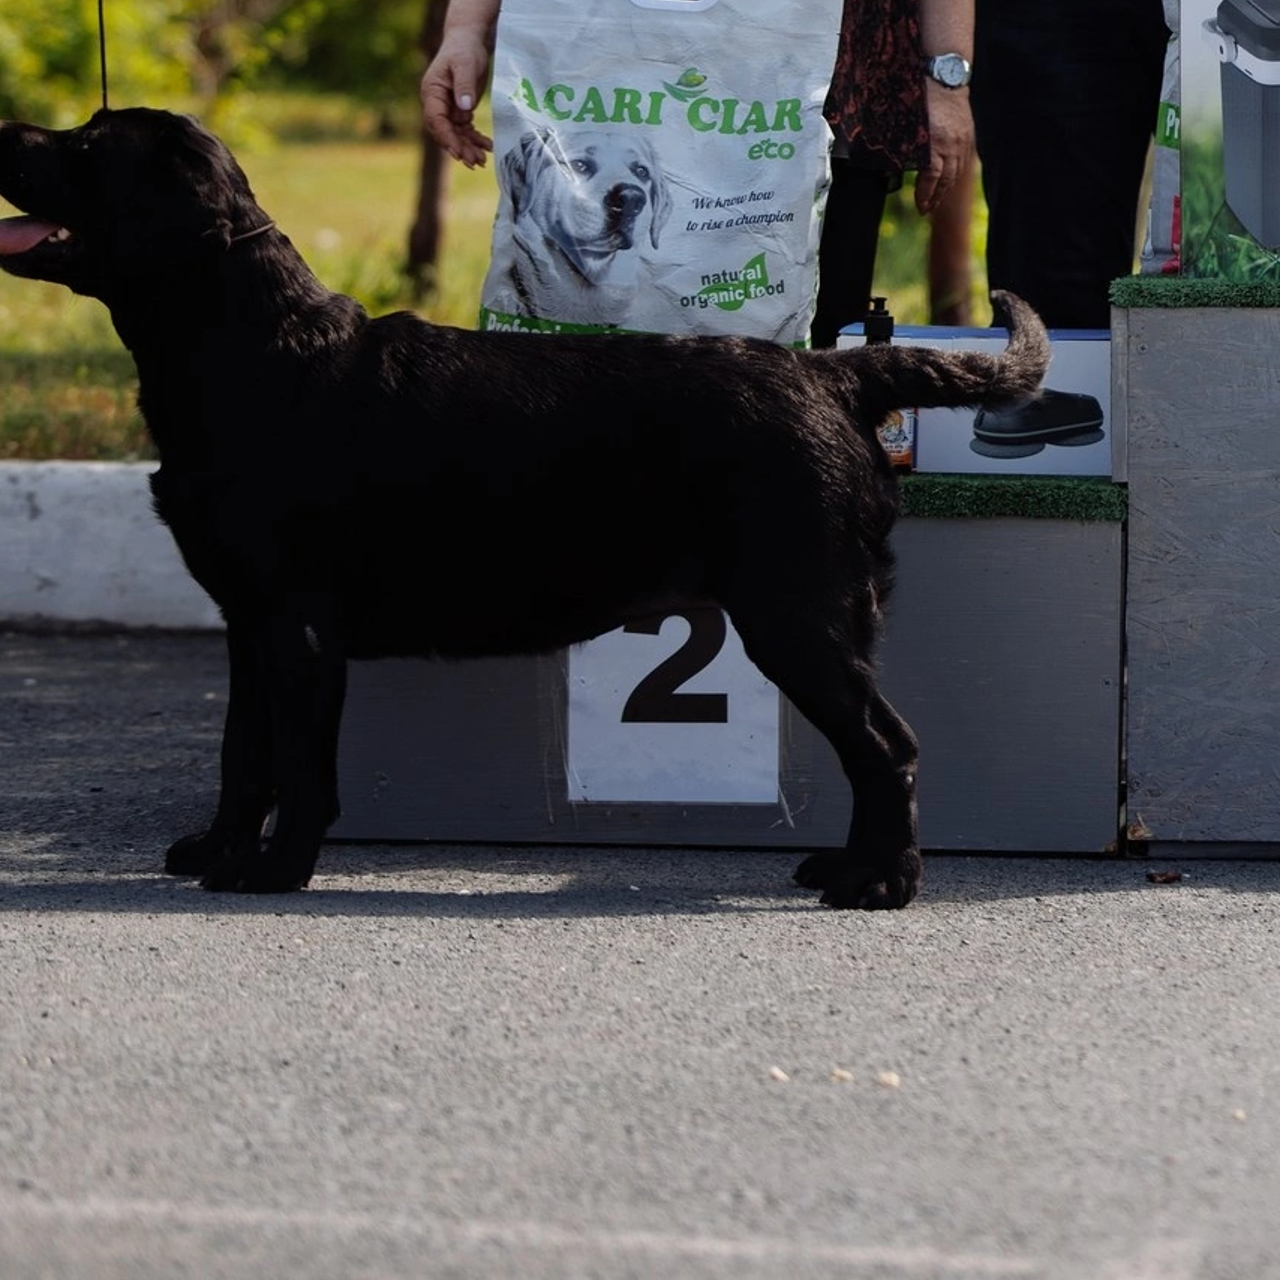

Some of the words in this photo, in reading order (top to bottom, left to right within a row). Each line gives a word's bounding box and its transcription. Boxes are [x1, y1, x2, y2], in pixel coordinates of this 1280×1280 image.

[511, 77, 666, 125] ACARI
[687, 97, 803, 134] CIAR
[748, 138, 795, 160] eco
[692, 197, 714, 209] We
[714, 194, 748, 208] know
[748, 191, 775, 202] how
[685, 221, 699, 231] to
[701, 218, 723, 231] rise
[725, 219, 734, 228] a
[735, 210, 795, 226] champion
[701, 264, 762, 286] natural
[680, 286, 745, 309] organic
[749, 280, 785, 298] food
[621, 606, 728, 723] 2
